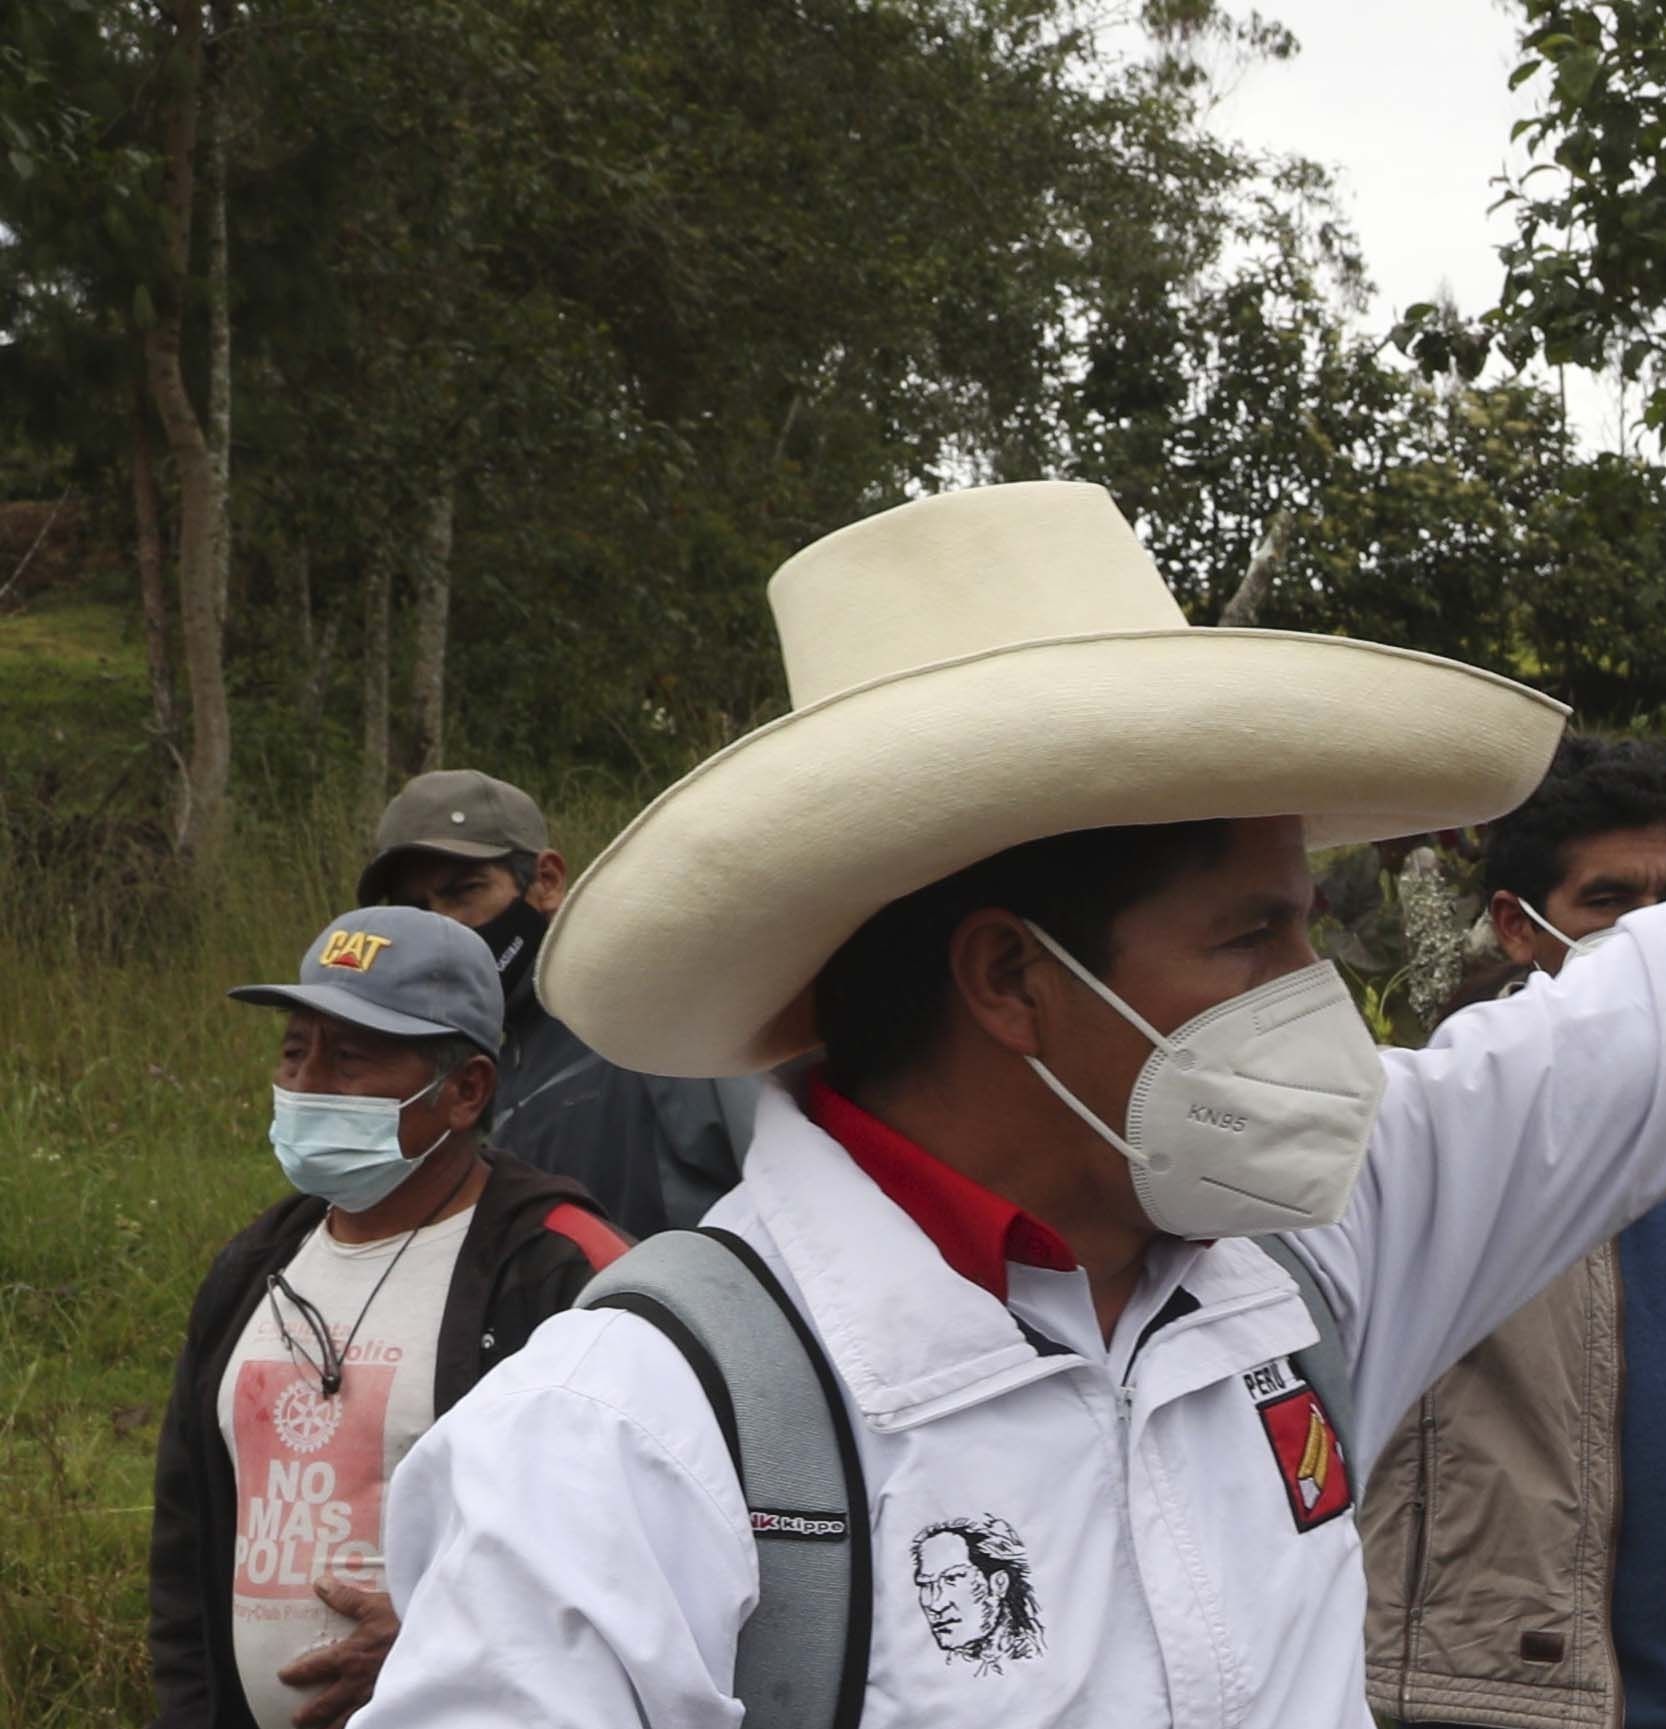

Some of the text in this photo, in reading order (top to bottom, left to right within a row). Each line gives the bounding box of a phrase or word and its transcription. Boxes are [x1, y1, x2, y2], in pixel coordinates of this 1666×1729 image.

[319, 929, 392, 973] CAT
[1186, 1104, 1249, 1132] KN95
[267, 1459, 336, 1503] NO
[247, 1496, 352, 1544] MAS
[781, 1516, 844, 1534] kippe
[234, 1537, 379, 1586] POLIO
